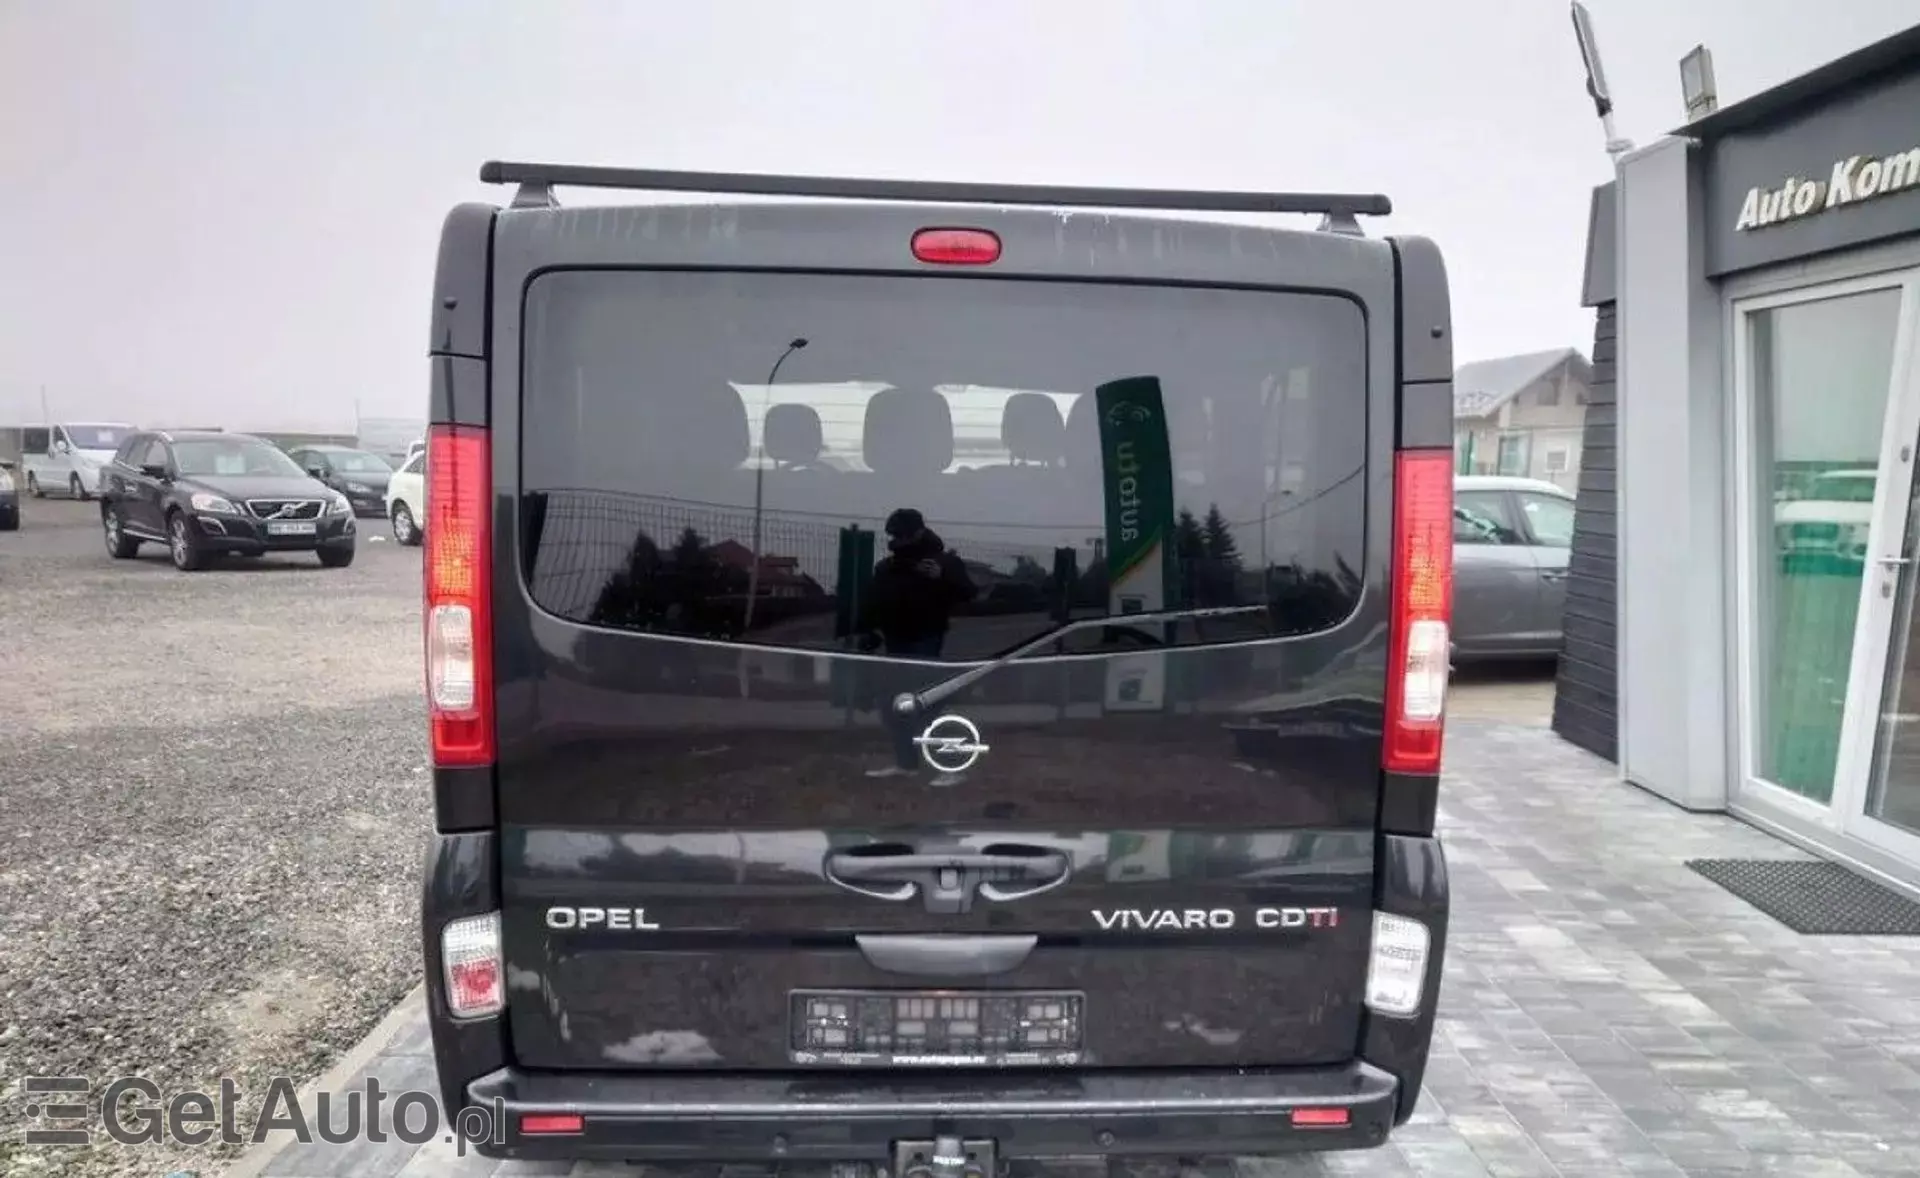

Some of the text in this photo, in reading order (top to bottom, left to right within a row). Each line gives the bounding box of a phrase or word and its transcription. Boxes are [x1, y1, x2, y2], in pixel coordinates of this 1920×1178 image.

[1734, 147, 1920, 231] Auto Kom
[546, 907, 660, 929] OPEL
[1091, 907, 1339, 929] VIVARO CDTI
